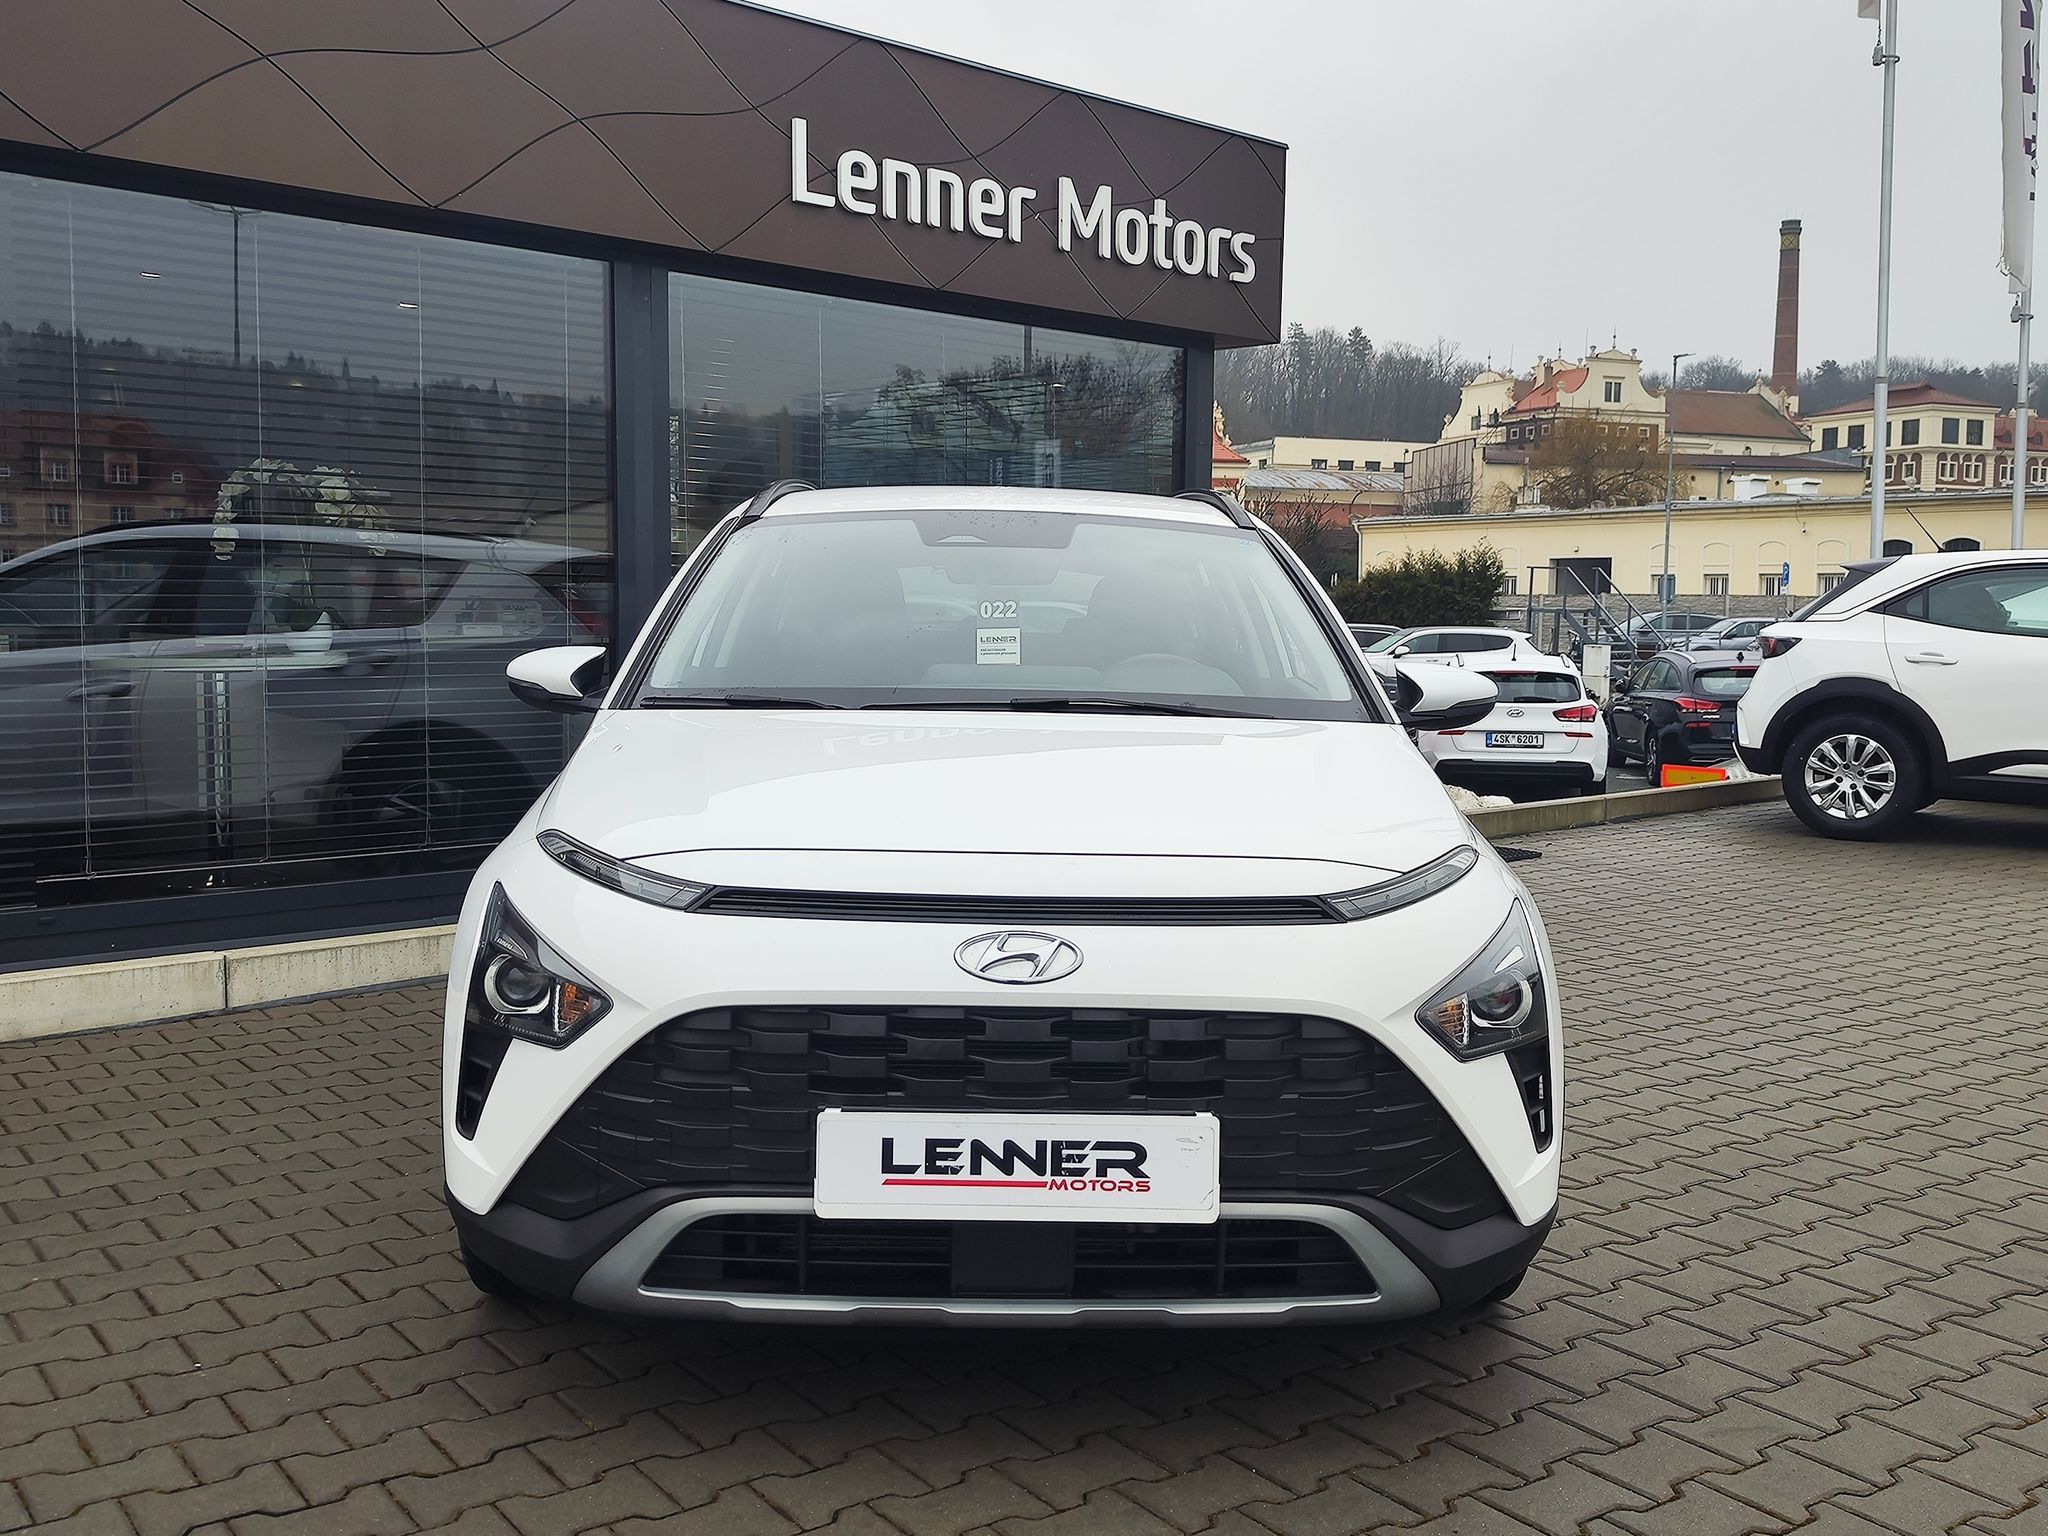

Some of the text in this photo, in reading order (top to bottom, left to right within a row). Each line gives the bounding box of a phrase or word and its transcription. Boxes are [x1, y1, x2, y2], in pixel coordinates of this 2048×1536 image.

[791, 117, 1256, 283] Lenner Motors
[980, 600, 1017, 618] 022
[1494, 734, 1511, 744] 4SK
[1517, 735, 1539, 744] 6201
[881, 1137, 1151, 1179] LENNER
[1047, 1178, 1151, 1192] MOTORS
